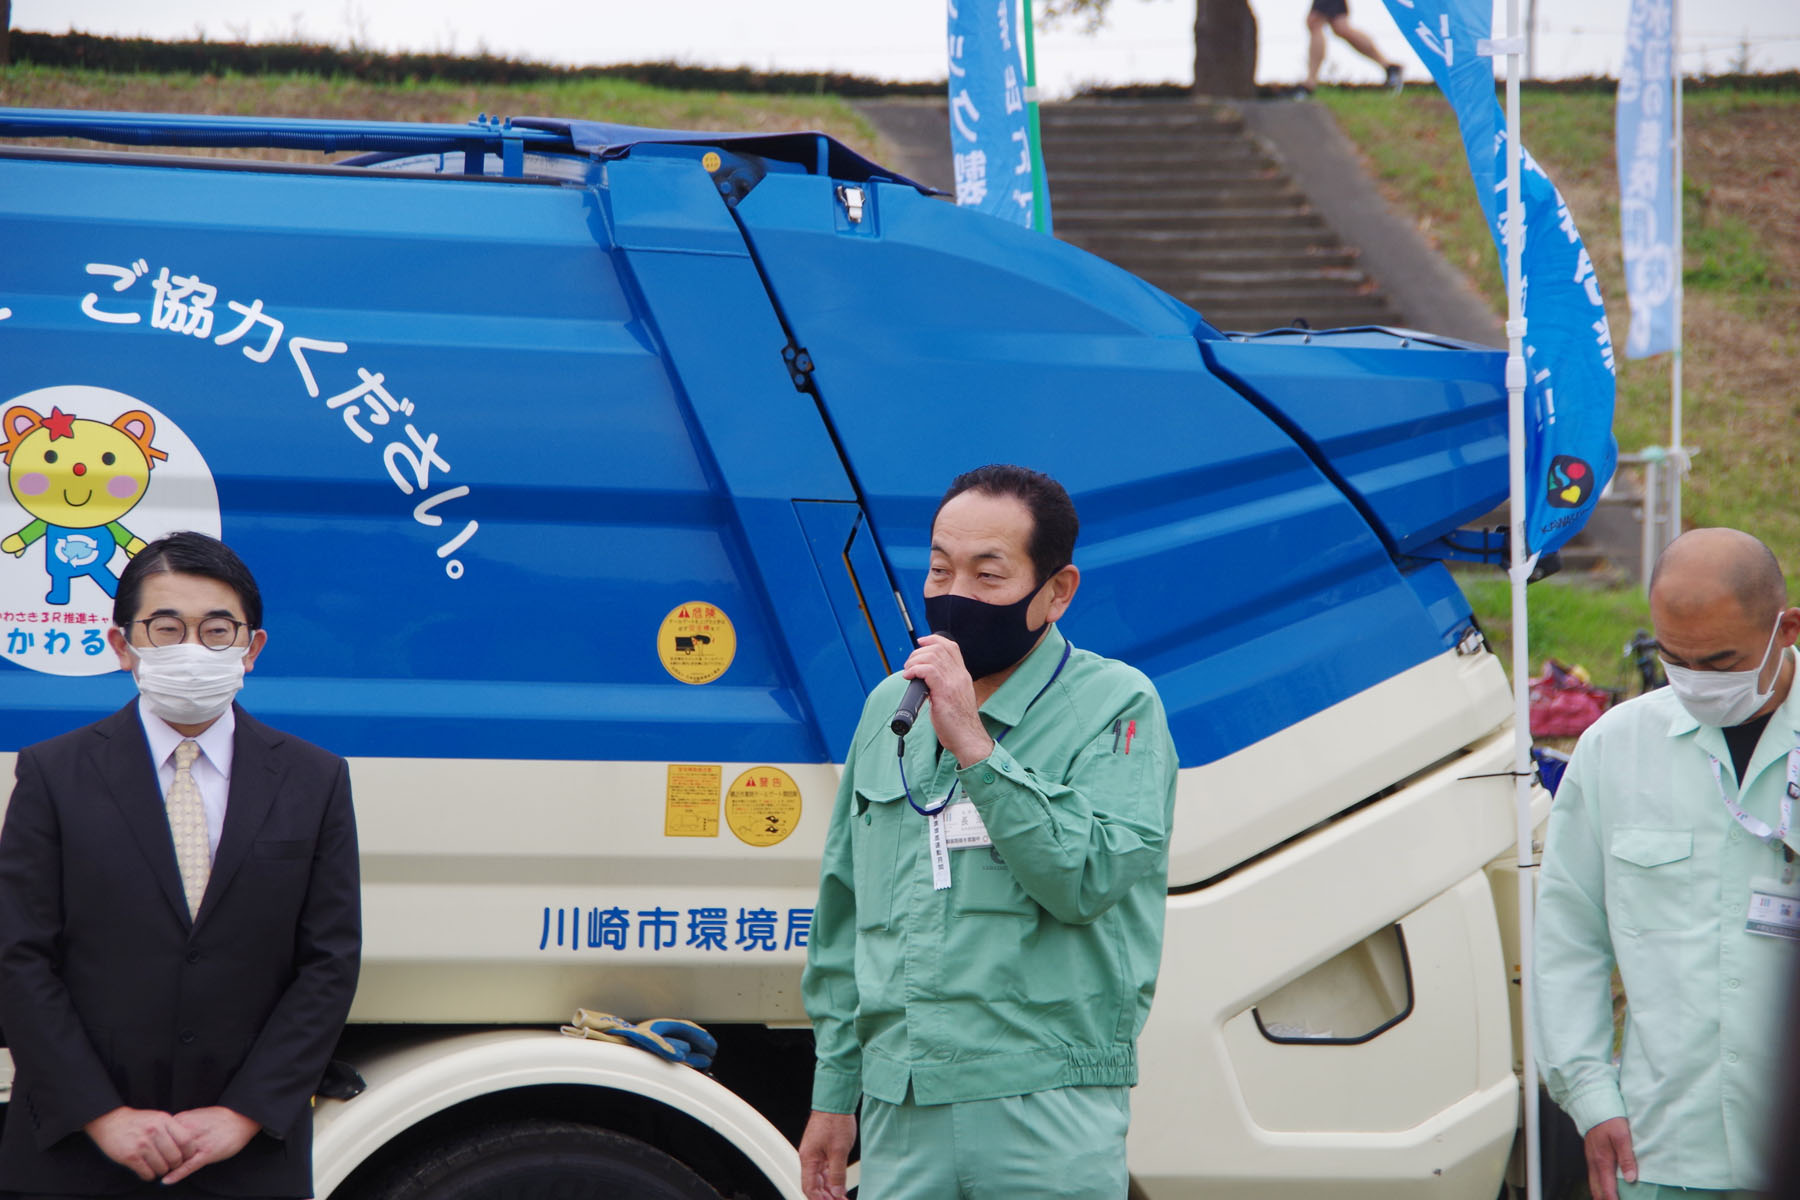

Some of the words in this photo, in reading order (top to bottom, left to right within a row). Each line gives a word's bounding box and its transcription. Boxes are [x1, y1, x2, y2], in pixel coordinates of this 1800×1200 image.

[80, 258, 479, 580] ご協力ください。
[0, 611, 109, 624] わさき3R推進キャ
